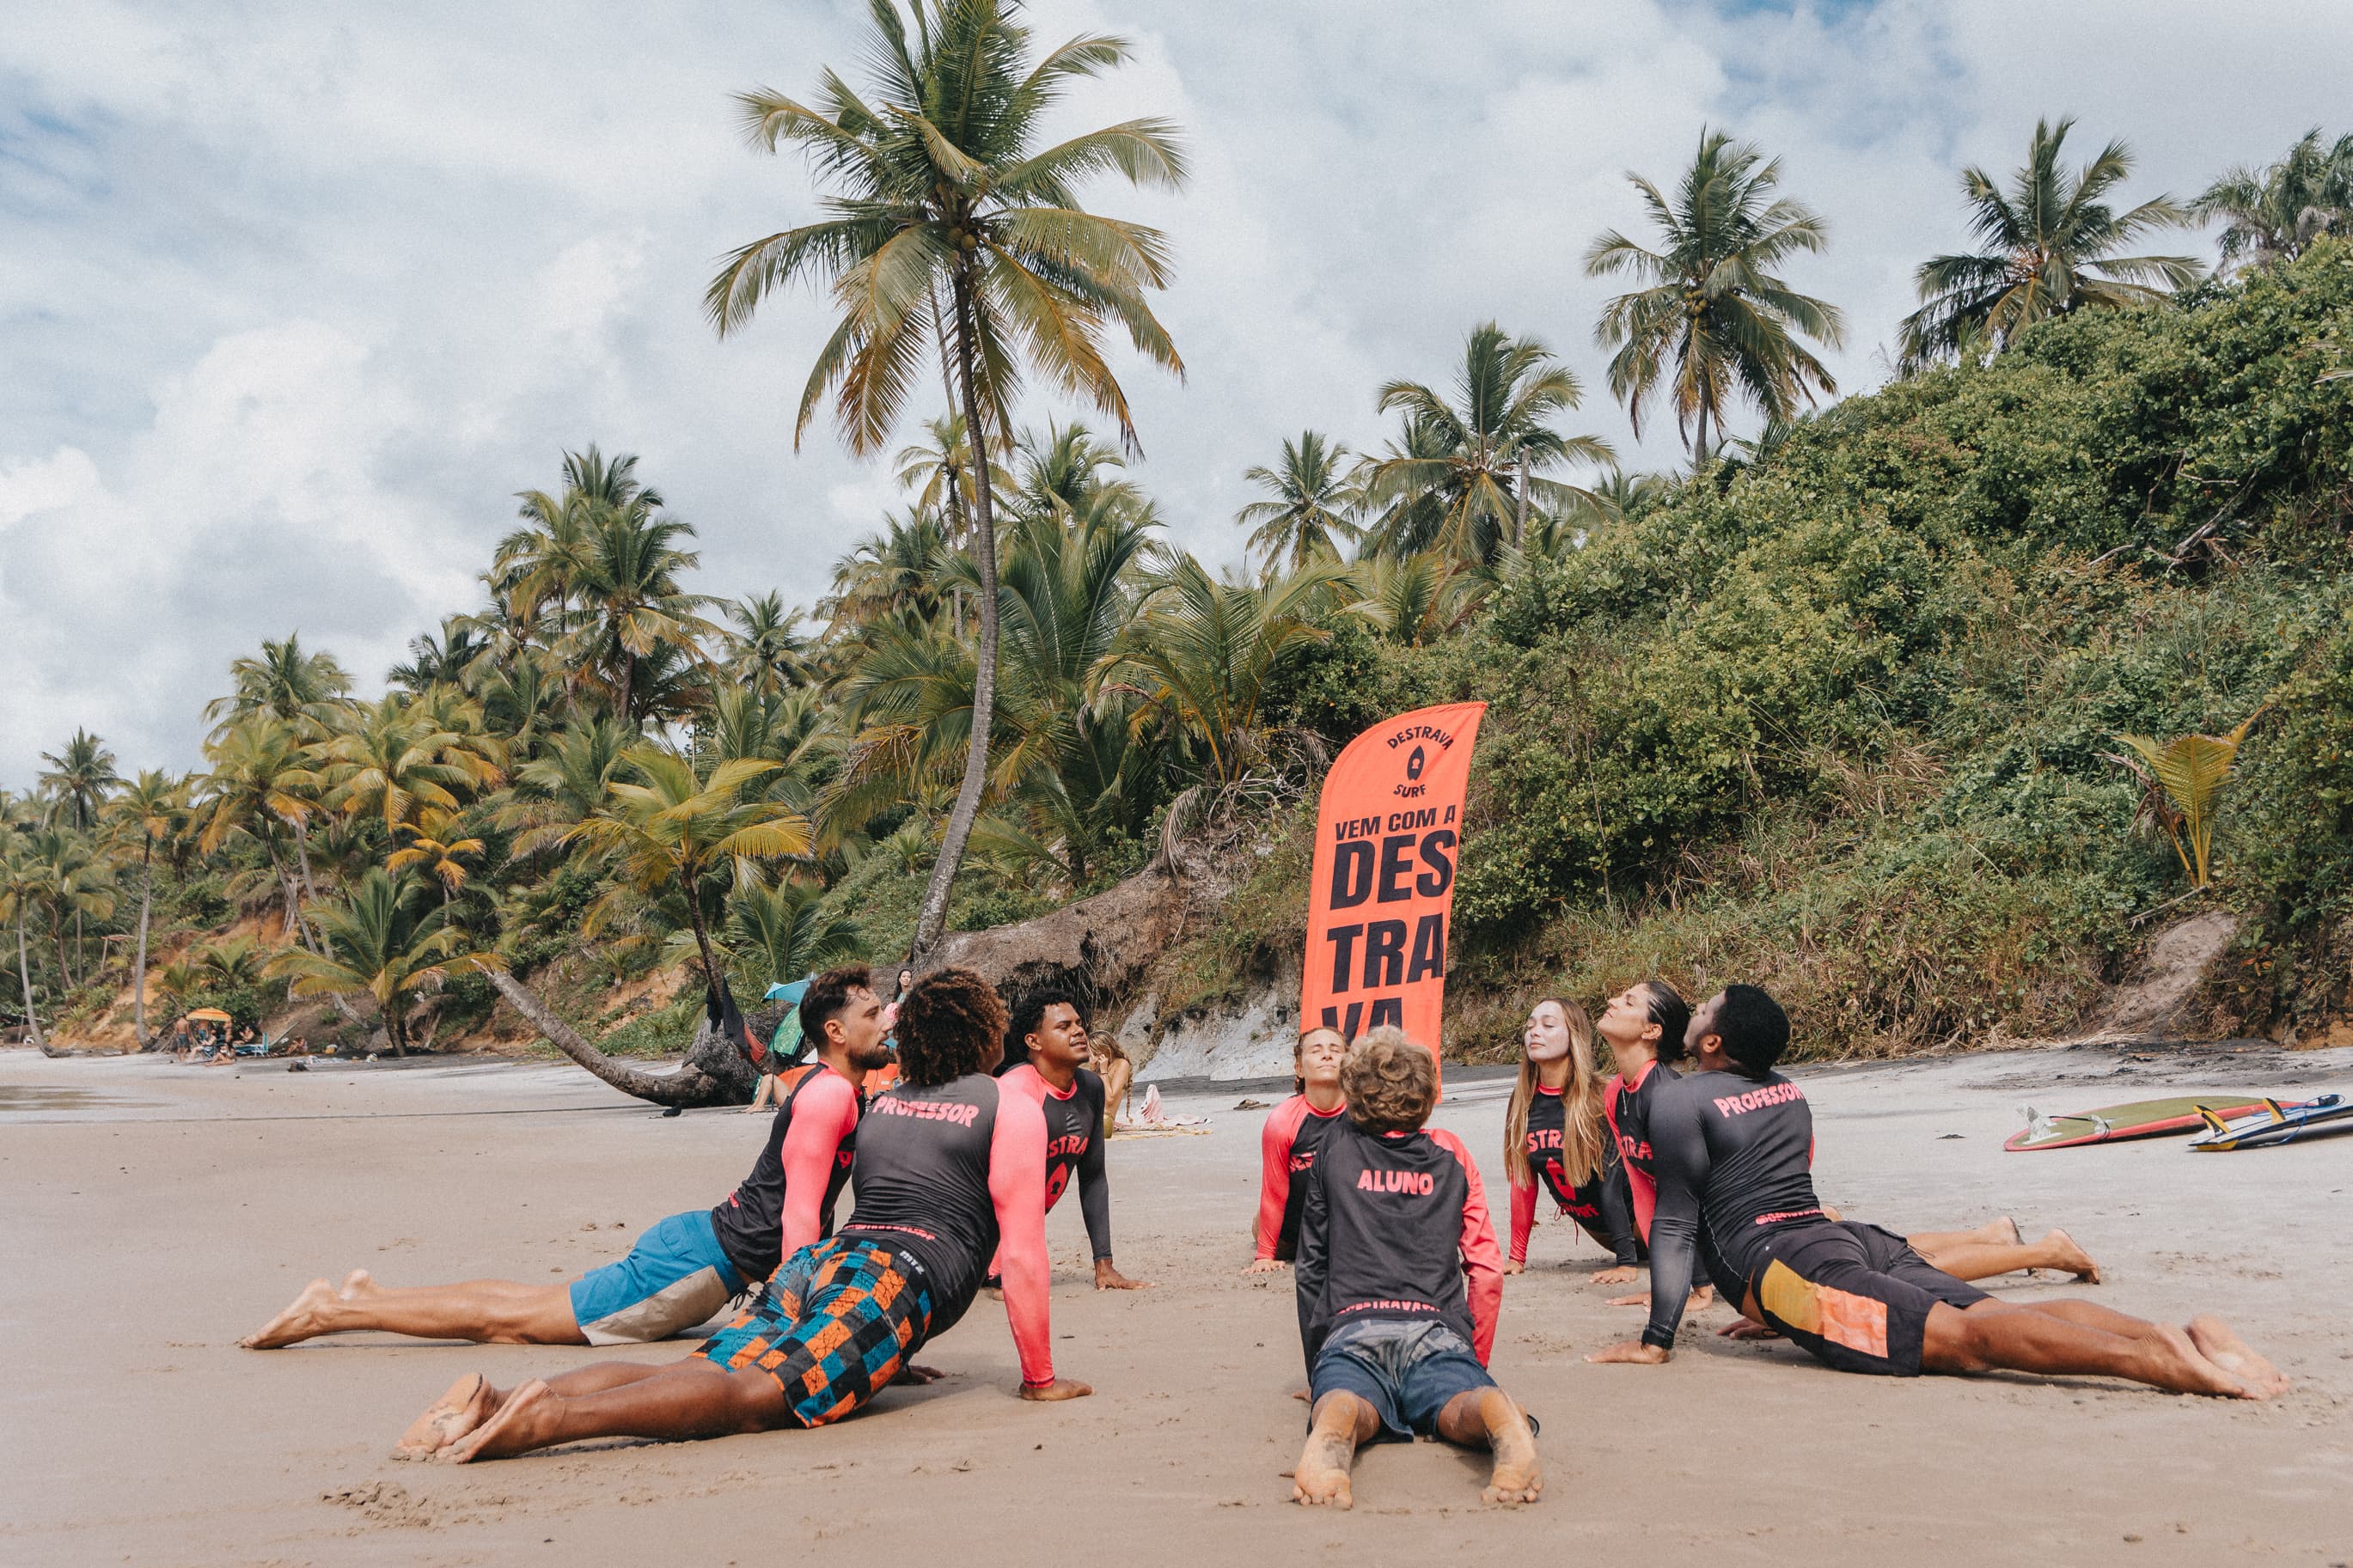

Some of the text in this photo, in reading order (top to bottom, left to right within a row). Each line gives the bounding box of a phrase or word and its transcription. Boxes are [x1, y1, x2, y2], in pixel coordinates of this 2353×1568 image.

[1386, 726, 1454, 751] DESTRAVA
[1393, 784, 1427, 798] SURF
[1335, 804, 1457, 841] VEM COM A
[1329, 829, 1457, 911] DES
[1326, 912, 1445, 994] TRA
[872, 1095, 980, 1128] PROFESSOR
[1046, 1134, 1089, 1159] STRA
[1525, 1129, 1564, 1154] STR
[1357, 1169, 1434, 1196] ALUNO
